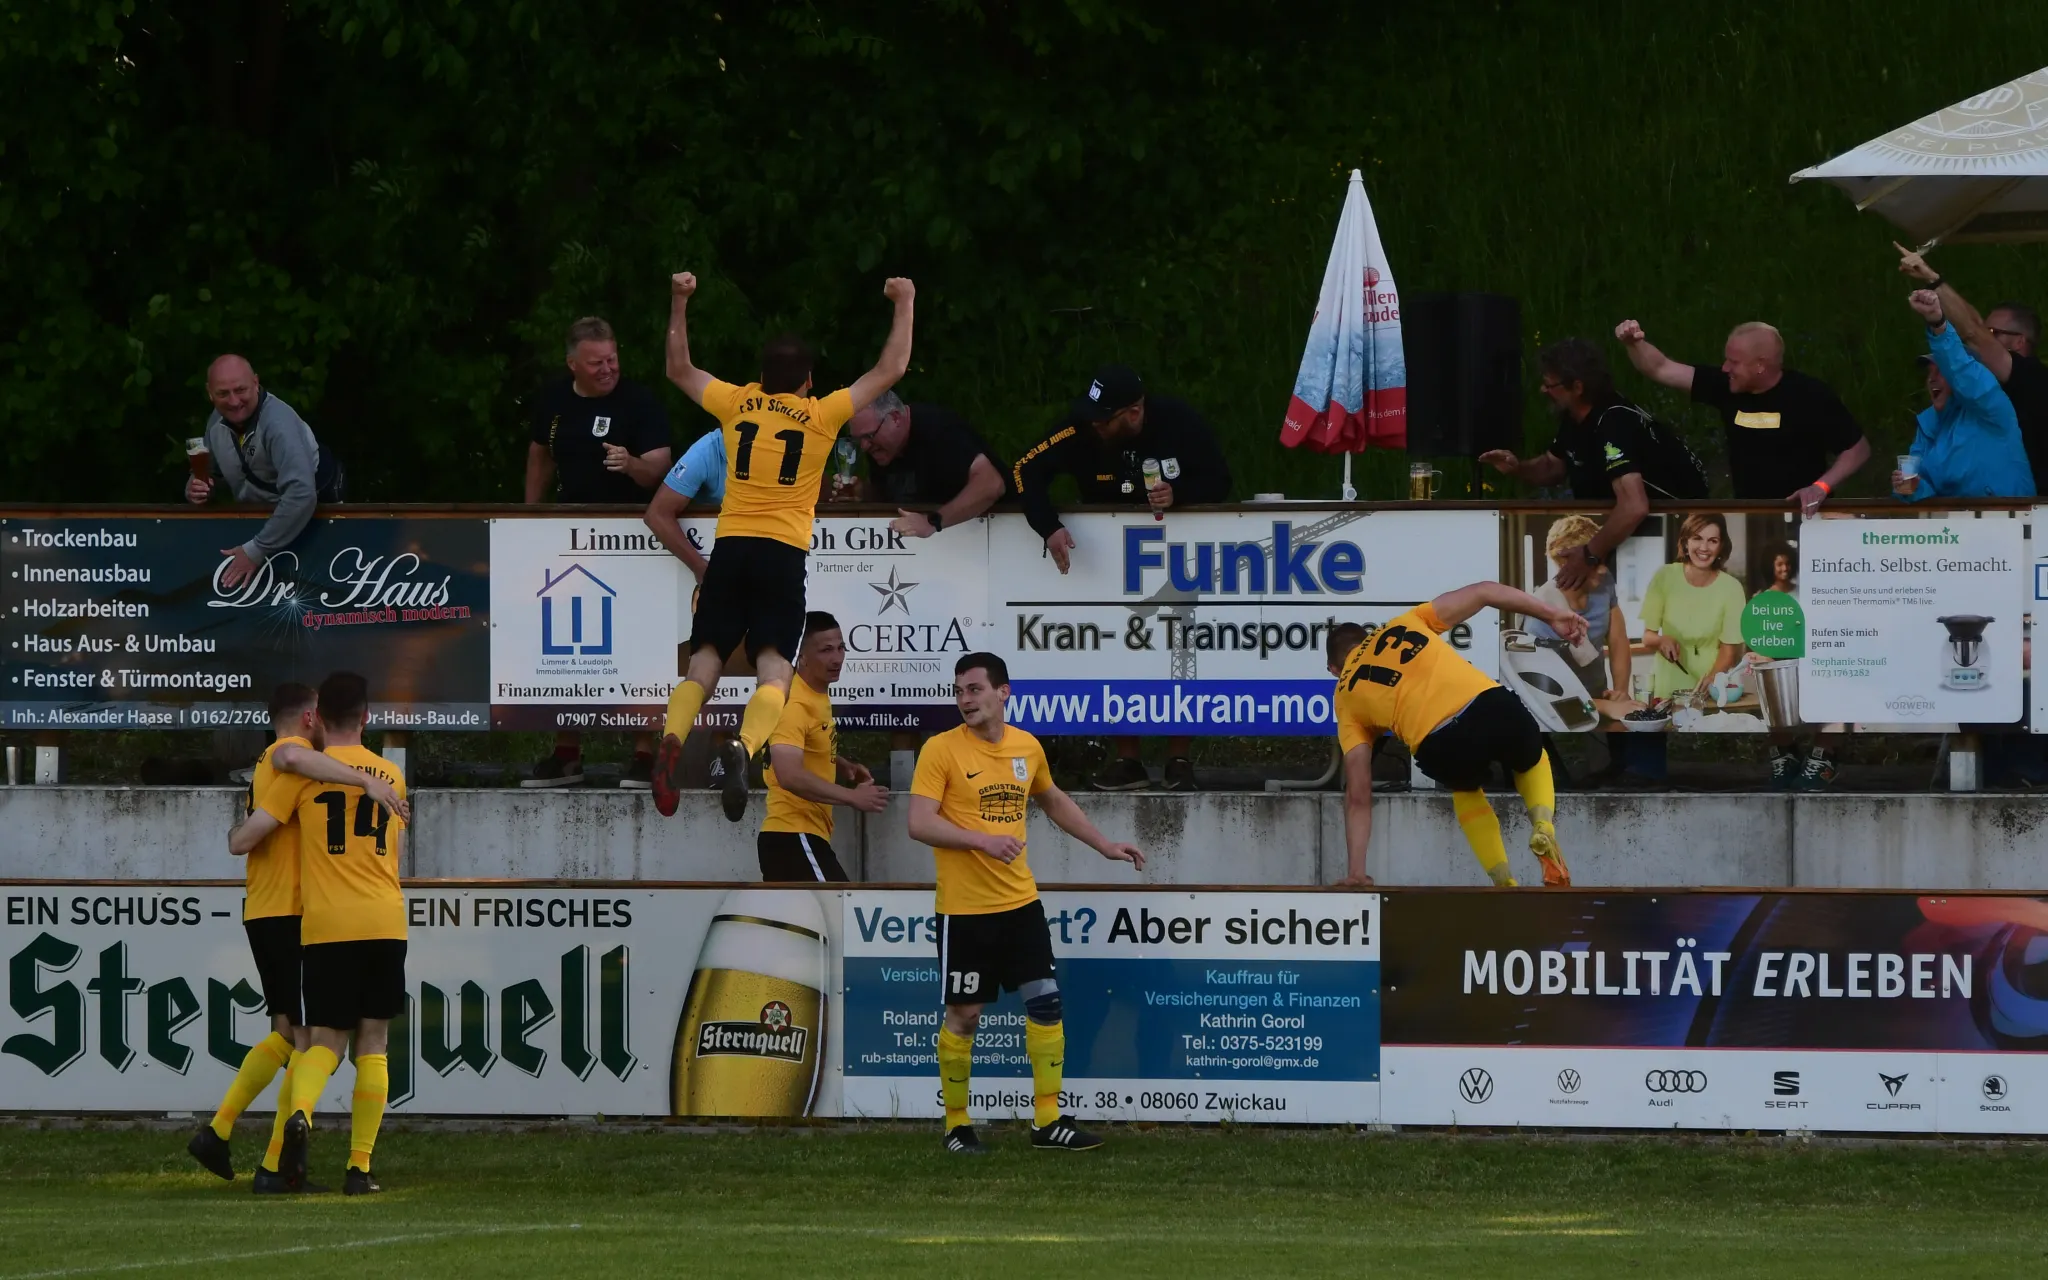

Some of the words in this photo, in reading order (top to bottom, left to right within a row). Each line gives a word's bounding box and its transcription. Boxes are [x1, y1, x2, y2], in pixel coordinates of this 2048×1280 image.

[1895, 132, 1947, 151] REI
[1285, 415, 1301, 431] wald
[1049, 426, 1077, 446] JUNGS
[735, 420, 804, 485] 11
[22, 529, 137, 548] Trockenbau
[686, 528, 704, 550] &
[845, 527, 907, 550] GbR
[1862, 527, 1959, 545] thermomix
[1123, 520, 1366, 595] Funke
[1811, 558, 1876, 573] Einfach.
[1880, 558, 1932, 573] Selbst.
[1937, 557, 2012, 573] Gemacht.
[24, 564, 151, 583] Innenausbau
[816, 562, 854, 573] Partner
[856, 562, 874, 573] der
[207, 551, 298, 607] Dr
[320, 547, 451, 608] Haus
[1811, 587, 1848, 595] Besuchen
[1925, 586, 1936, 594] Sie
[24, 599, 149, 618] Holzarbeiten
[303, 606, 397, 630] dynamisch
[402, 604, 471, 622] modern
[1752, 604, 1770, 616] bei
[1772, 606, 1794, 616] uns
[1762, 620, 1783, 631] live
[1811, 629, 1838, 637] Rufen
[1840, 629, 1854, 637] Sie
[1856, 628, 1879, 637] mich
[841, 617, 971, 652] CERTA
[1017, 614, 1116, 651] Kran-
[1124, 614, 1156, 651] &
[1157, 614, 1472, 660] Transporte
[1750, 636, 1795, 647] erleben
[24, 635, 72, 653] Haus
[77, 635, 120, 653] Aus-
[125, 635, 140, 653] &
[144, 635, 216, 654] Umbau
[1811, 641, 1832, 650] gern
[579, 659, 613, 668] Leudolph
[1348, 625, 1429, 692] 13
[1811, 657, 1855, 668] Stephanie
[1857, 657, 1887, 666] Strauß
[536, 668, 600, 676] Immobilienmakler
[602, 668, 619, 676] GbR
[846, 663, 941, 673] MAKLERUNION
[1811, 669, 1831, 678] 0173
[24, 670, 95, 688] Fenster
[100, 670, 115, 688] &
[119, 670, 252, 693] Türmontagen
[498, 683, 604, 698] Finanzmakler
[620, 683, 737, 701] Versichgen
[891, 684, 955, 698] Immobil
[1003, 685, 1337, 723] www.baukran-mo
[1885, 701, 1936, 710] VORWERK
[12, 710, 44, 725] Inh.:
[48, 709, 124, 725] Alexander
[128, 710, 172, 726] Haase
[191, 710, 270, 727] 0162/2760
[365, 709, 479, 725] Dr-Haus-Bau.de
[557, 713, 597, 726] 07907
[601, 712, 648, 726] Schleiz
[706, 713, 738, 726] 0173
[832, 713, 920, 727] www.filile.de
[978, 783, 1026, 796] GERÜSTBAU
[314, 791, 390, 857] 14
[981, 812, 1023, 824] LIPPOLD
[7, 897, 59, 925] EIN
[71, 896, 201, 926] SCHUSS
[408, 898, 460, 927] EIN
[474, 898, 632, 928] FRISCHES
[1107, 908, 1211, 944] Aber
[1225, 909, 1370, 945] sicher!
[881, 968, 941, 982] Versich
[1463, 937, 1731, 998] MOBILITÄT
[1753, 952, 1972, 999] ERLEBEN
[949, 971, 980, 994] 19
[1206, 970, 1273, 985] Kauffrau
[1278, 970, 1300, 985] für
[1145, 992, 1267, 1010] Versicherungen
[1273, 993, 1284, 1006] &
[1289, 993, 1361, 1008] Finanzen
[1, 931, 638, 1111] Steruell
[883, 1011, 938, 1026] Roland
[1200, 1014, 1256, 1029] Kathrin
[1261, 1014, 1305, 1029] Gorol
[700, 1022, 802, 1056] Sternquell
[894, 1033, 926, 1047] Tel.:
[1182, 1035, 1215, 1050] Tel.:
[1220, 1035, 1323, 1051] 0375-523199
[1186, 1056, 1319, 1069] kathrin-gorol@gmx.de
[936, 1091, 1034, 1114] Sinpleise
[1057, 1091, 1088, 1108] Str.
[1095, 1092, 1117, 1108] 38
[1141, 1092, 1198, 1109] 08060
[1205, 1093, 1286, 1110] Zwickau
[1648, 1098, 1673, 1107] Audi
[1980, 1104, 2010, 1112] ŠKODA
